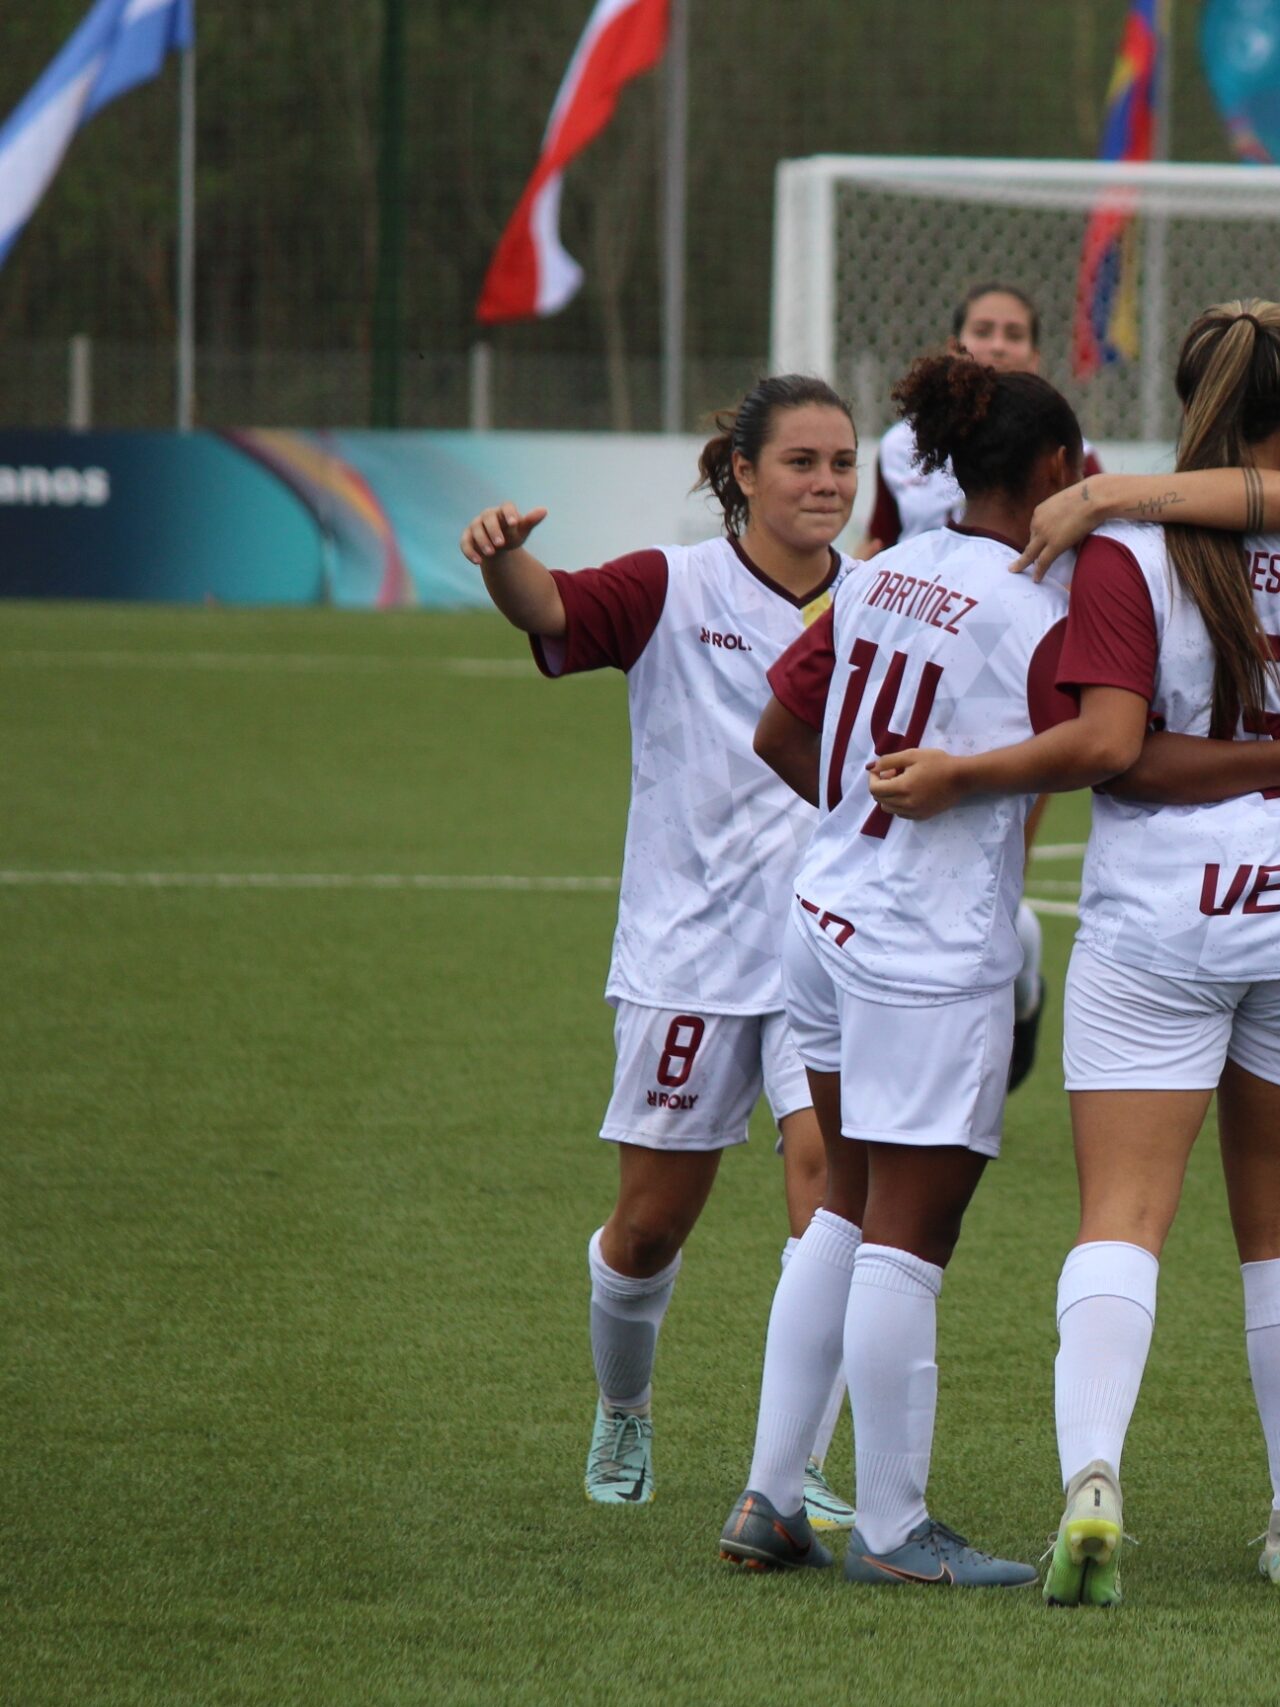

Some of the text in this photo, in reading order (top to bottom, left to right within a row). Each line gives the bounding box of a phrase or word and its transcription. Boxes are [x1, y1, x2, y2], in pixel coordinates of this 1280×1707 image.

[862, 569, 979, 635] MARTÍNEZ
[711, 631, 752, 651] ROL
[826, 637, 945, 840] 14
[657, 1014, 705, 1088] 8
[659, 1092, 699, 1110] ROLY
